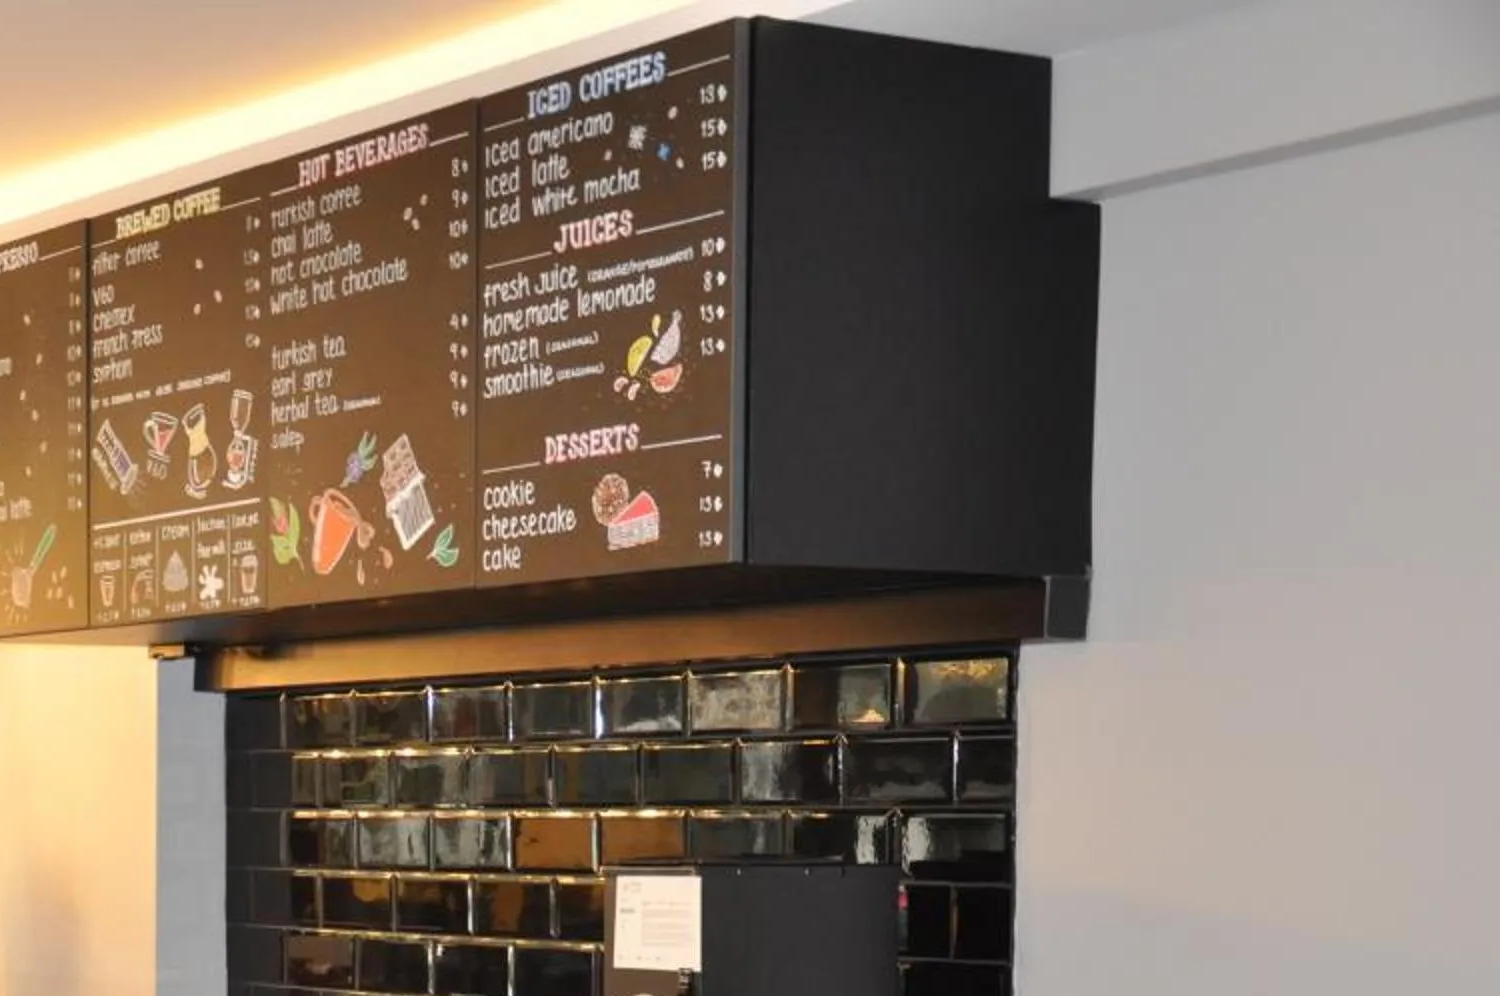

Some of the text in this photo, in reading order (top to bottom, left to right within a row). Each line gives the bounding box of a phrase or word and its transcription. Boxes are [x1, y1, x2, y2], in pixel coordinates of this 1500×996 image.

[527, 52, 666, 119] ICED COFFEES
[300, 123, 428, 185] HOT BEVERAGES
[485, 111, 614, 168] iced americano
[485, 153, 570, 199] iced latte
[485, 166, 641, 229] iced white mocha
[117, 188, 220, 238] BREWED COFFEE
[304, 221, 332, 248] latte
[554, 210, 633, 253] JUICES
[301, 241, 362, 277] chocolate
[312, 277, 335, 303] hot
[342, 257, 407, 295] chocolate
[484, 275, 656, 338] homemade lemonade
[485, 271, 529, 308] fresh
[534, 263, 577, 294] juice
[485, 336, 539, 369] frozen
[484, 363, 554, 399] smoothie
[545, 424, 640, 464] DESSERTS
[485, 480, 535, 509] cookie
[483, 504, 576, 540] cheesecake
[483, 544, 522, 571] cake
